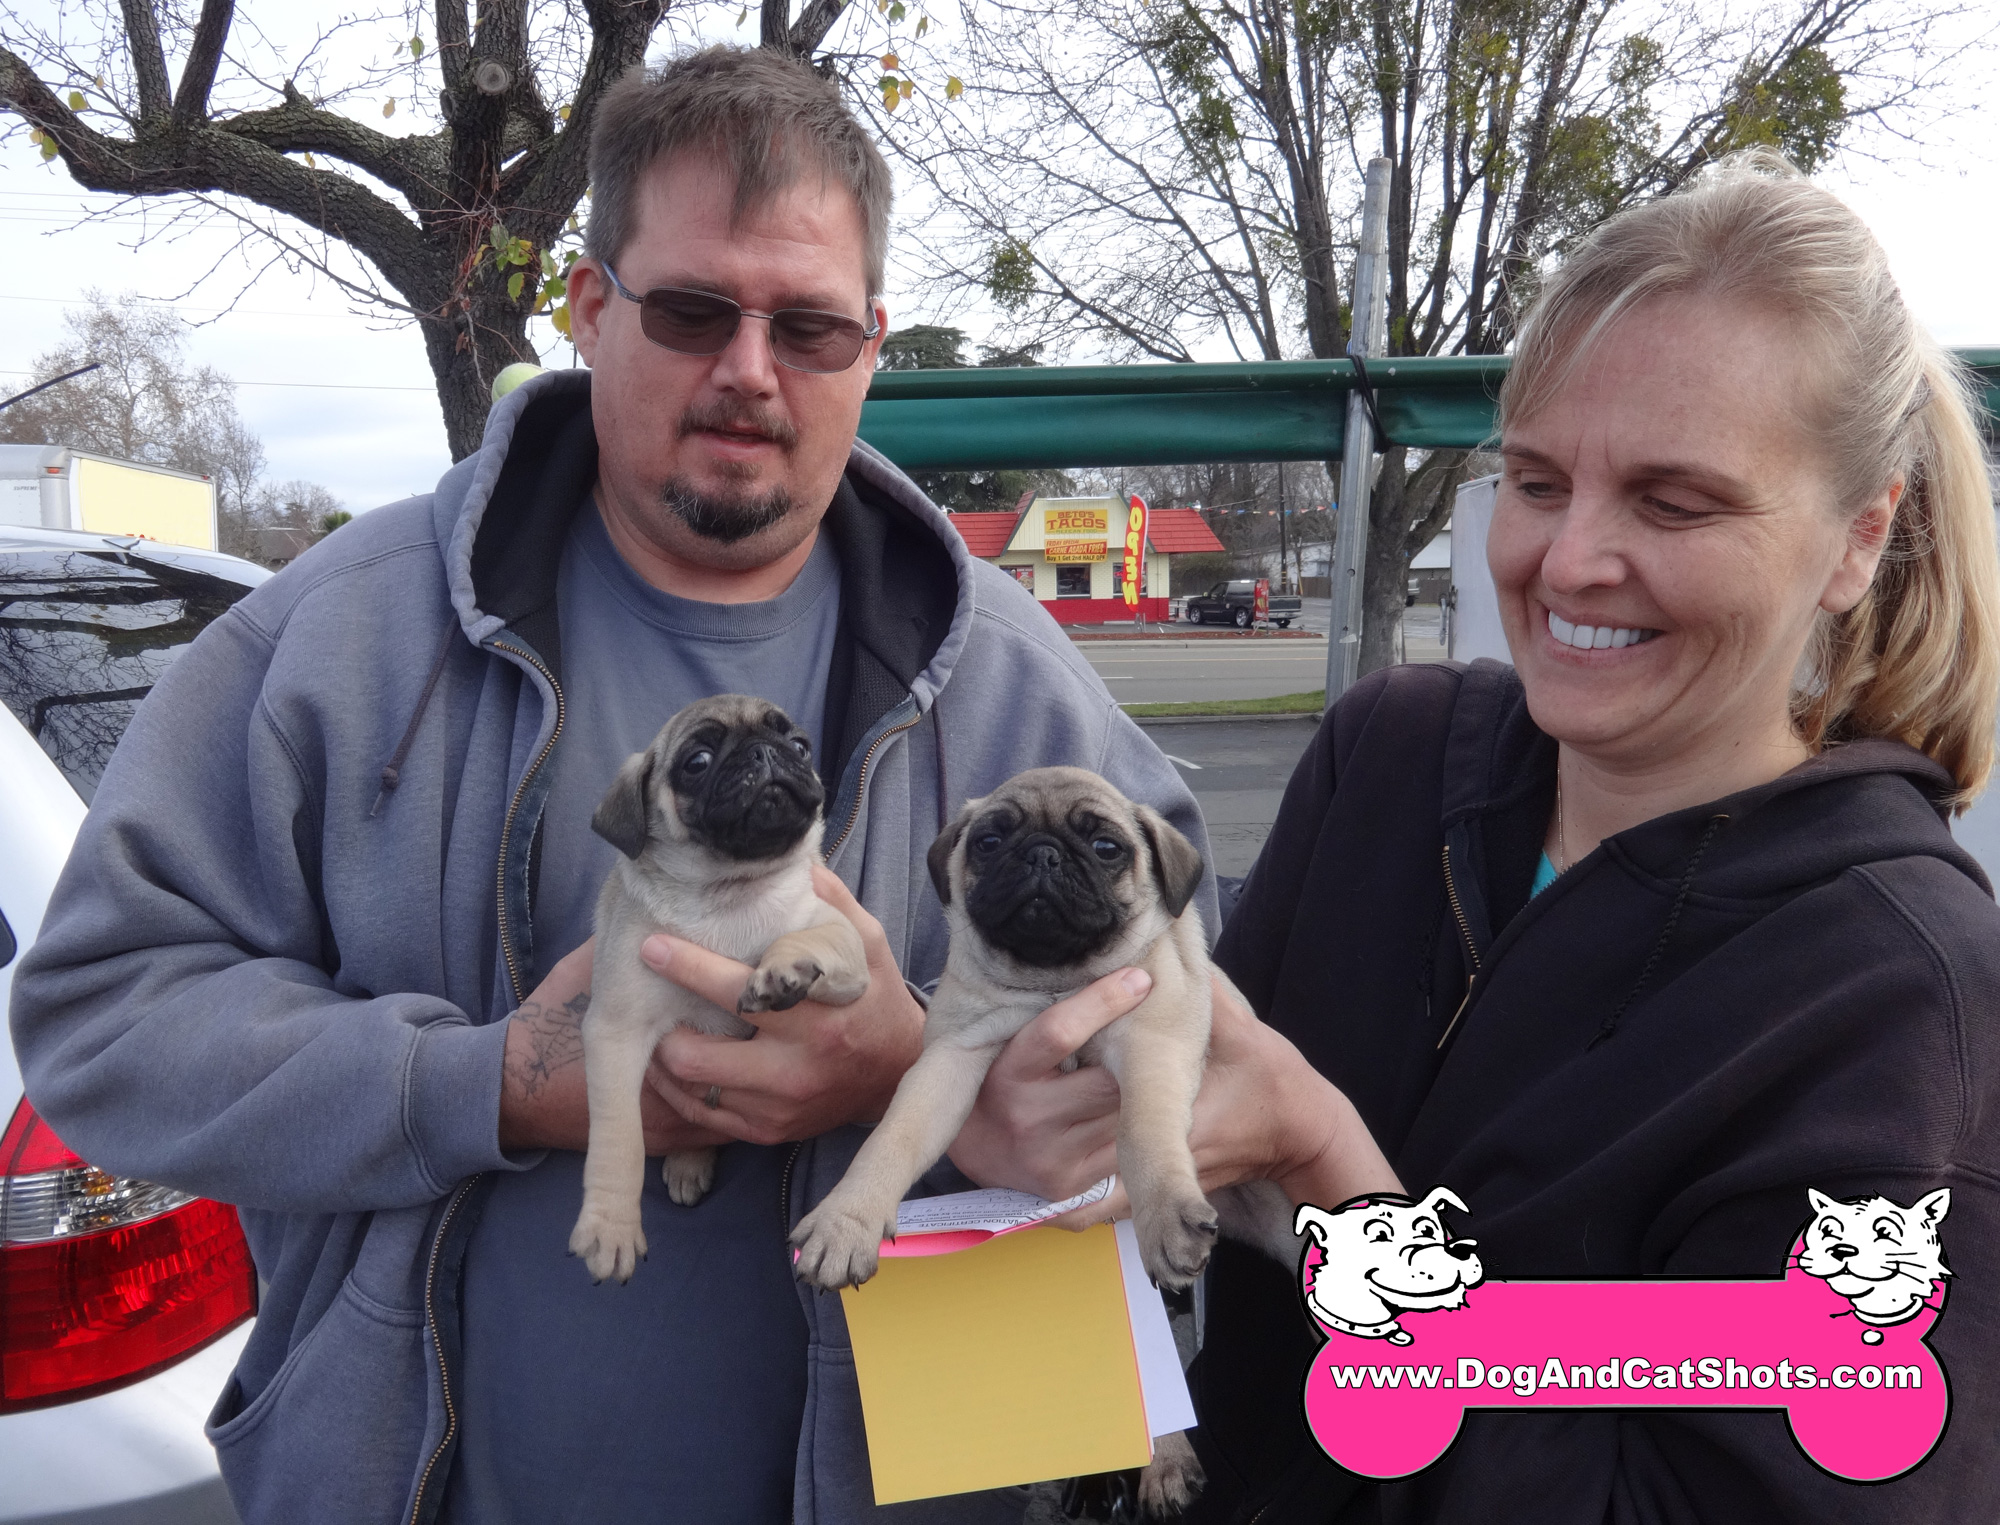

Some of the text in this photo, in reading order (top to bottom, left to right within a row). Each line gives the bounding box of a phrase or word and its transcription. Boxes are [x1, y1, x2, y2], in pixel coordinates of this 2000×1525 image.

[1057, 511, 1095, 519] BETO'S
[1046, 518, 1106, 530] TACOS
[1048, 546, 1067, 554] CARNE
[1068, 545, 1088, 554] ASADA
[919, 1219, 981, 1227] CERTIFICATE
